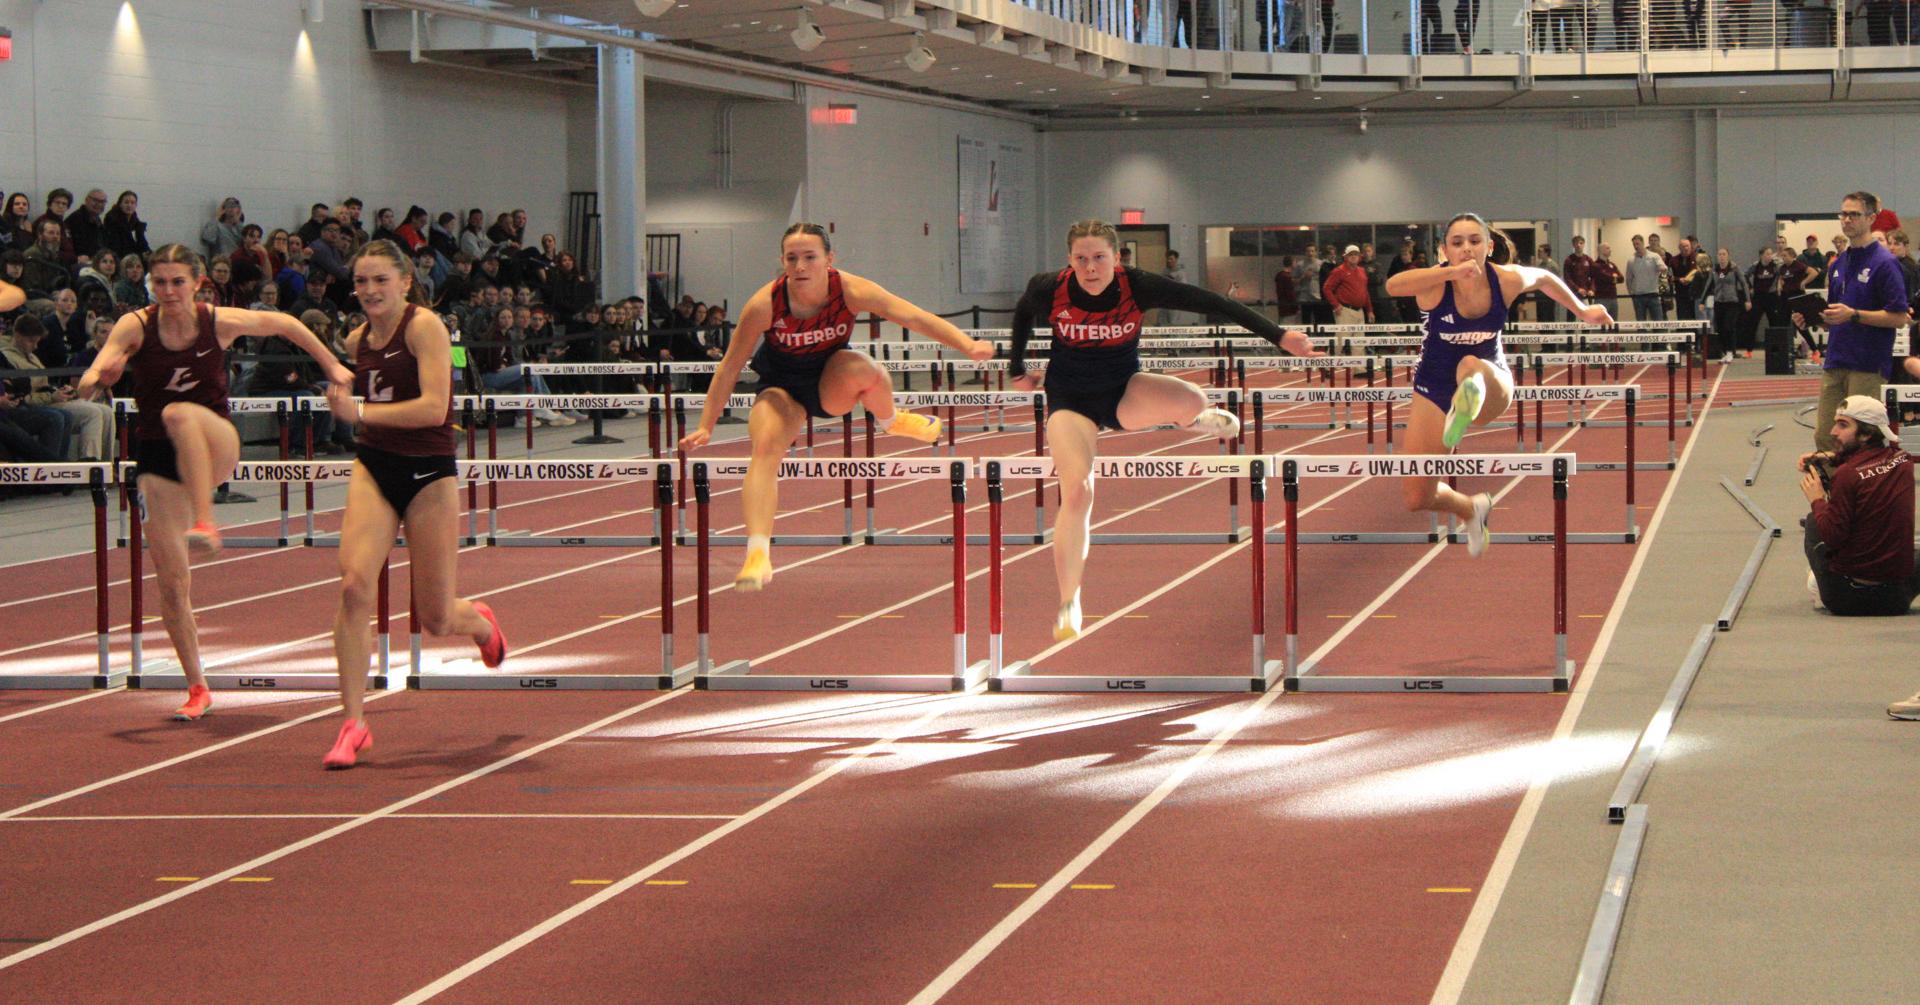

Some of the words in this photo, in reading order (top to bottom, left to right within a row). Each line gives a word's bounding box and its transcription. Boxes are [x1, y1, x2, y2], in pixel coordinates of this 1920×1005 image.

[776, 324, 847, 346] VITERBO
[1058, 322, 1135, 340] VITERBO
[1309, 392, 1341, 401] UW-LA
[1345, 391, 1384, 401] CROSSE
[1513, 389, 1537, 399] W-LA
[1542, 389, 1581, 399] CROSSE
[538, 399, 569, 408] UW-LA
[572, 398, 609, 408] CROSSE
[729, 397, 752, 407] UW-L
[918, 395, 949, 405] UW-LA
[953, 394, 991, 404] CROSSE
[486, 464, 532, 479] UW-LA
[538, 464, 594, 479] CROSSE
[828, 462, 886, 477] CROSSE
[1095, 462, 1119, 477] -LA
[1124, 462, 1183, 477] CROSSE
[1307, 464, 1339, 473] UCS
[1369, 460, 1418, 475] UW-LA
[1424, 459, 1485, 475] CROSSE
[1509, 463, 1542, 471] UCS
[1859, 470, 1875, 480] LA
[1876, 454, 1908, 474] CROSSE
[255, 466, 311, 480] CROSSE
[239, 678, 275, 687] UCS
[520, 678, 558, 688] UCS
[810, 678, 848, 688] UCS
[1107, 680, 1146, 690] UCS
[1404, 680, 1443, 690] UCS
